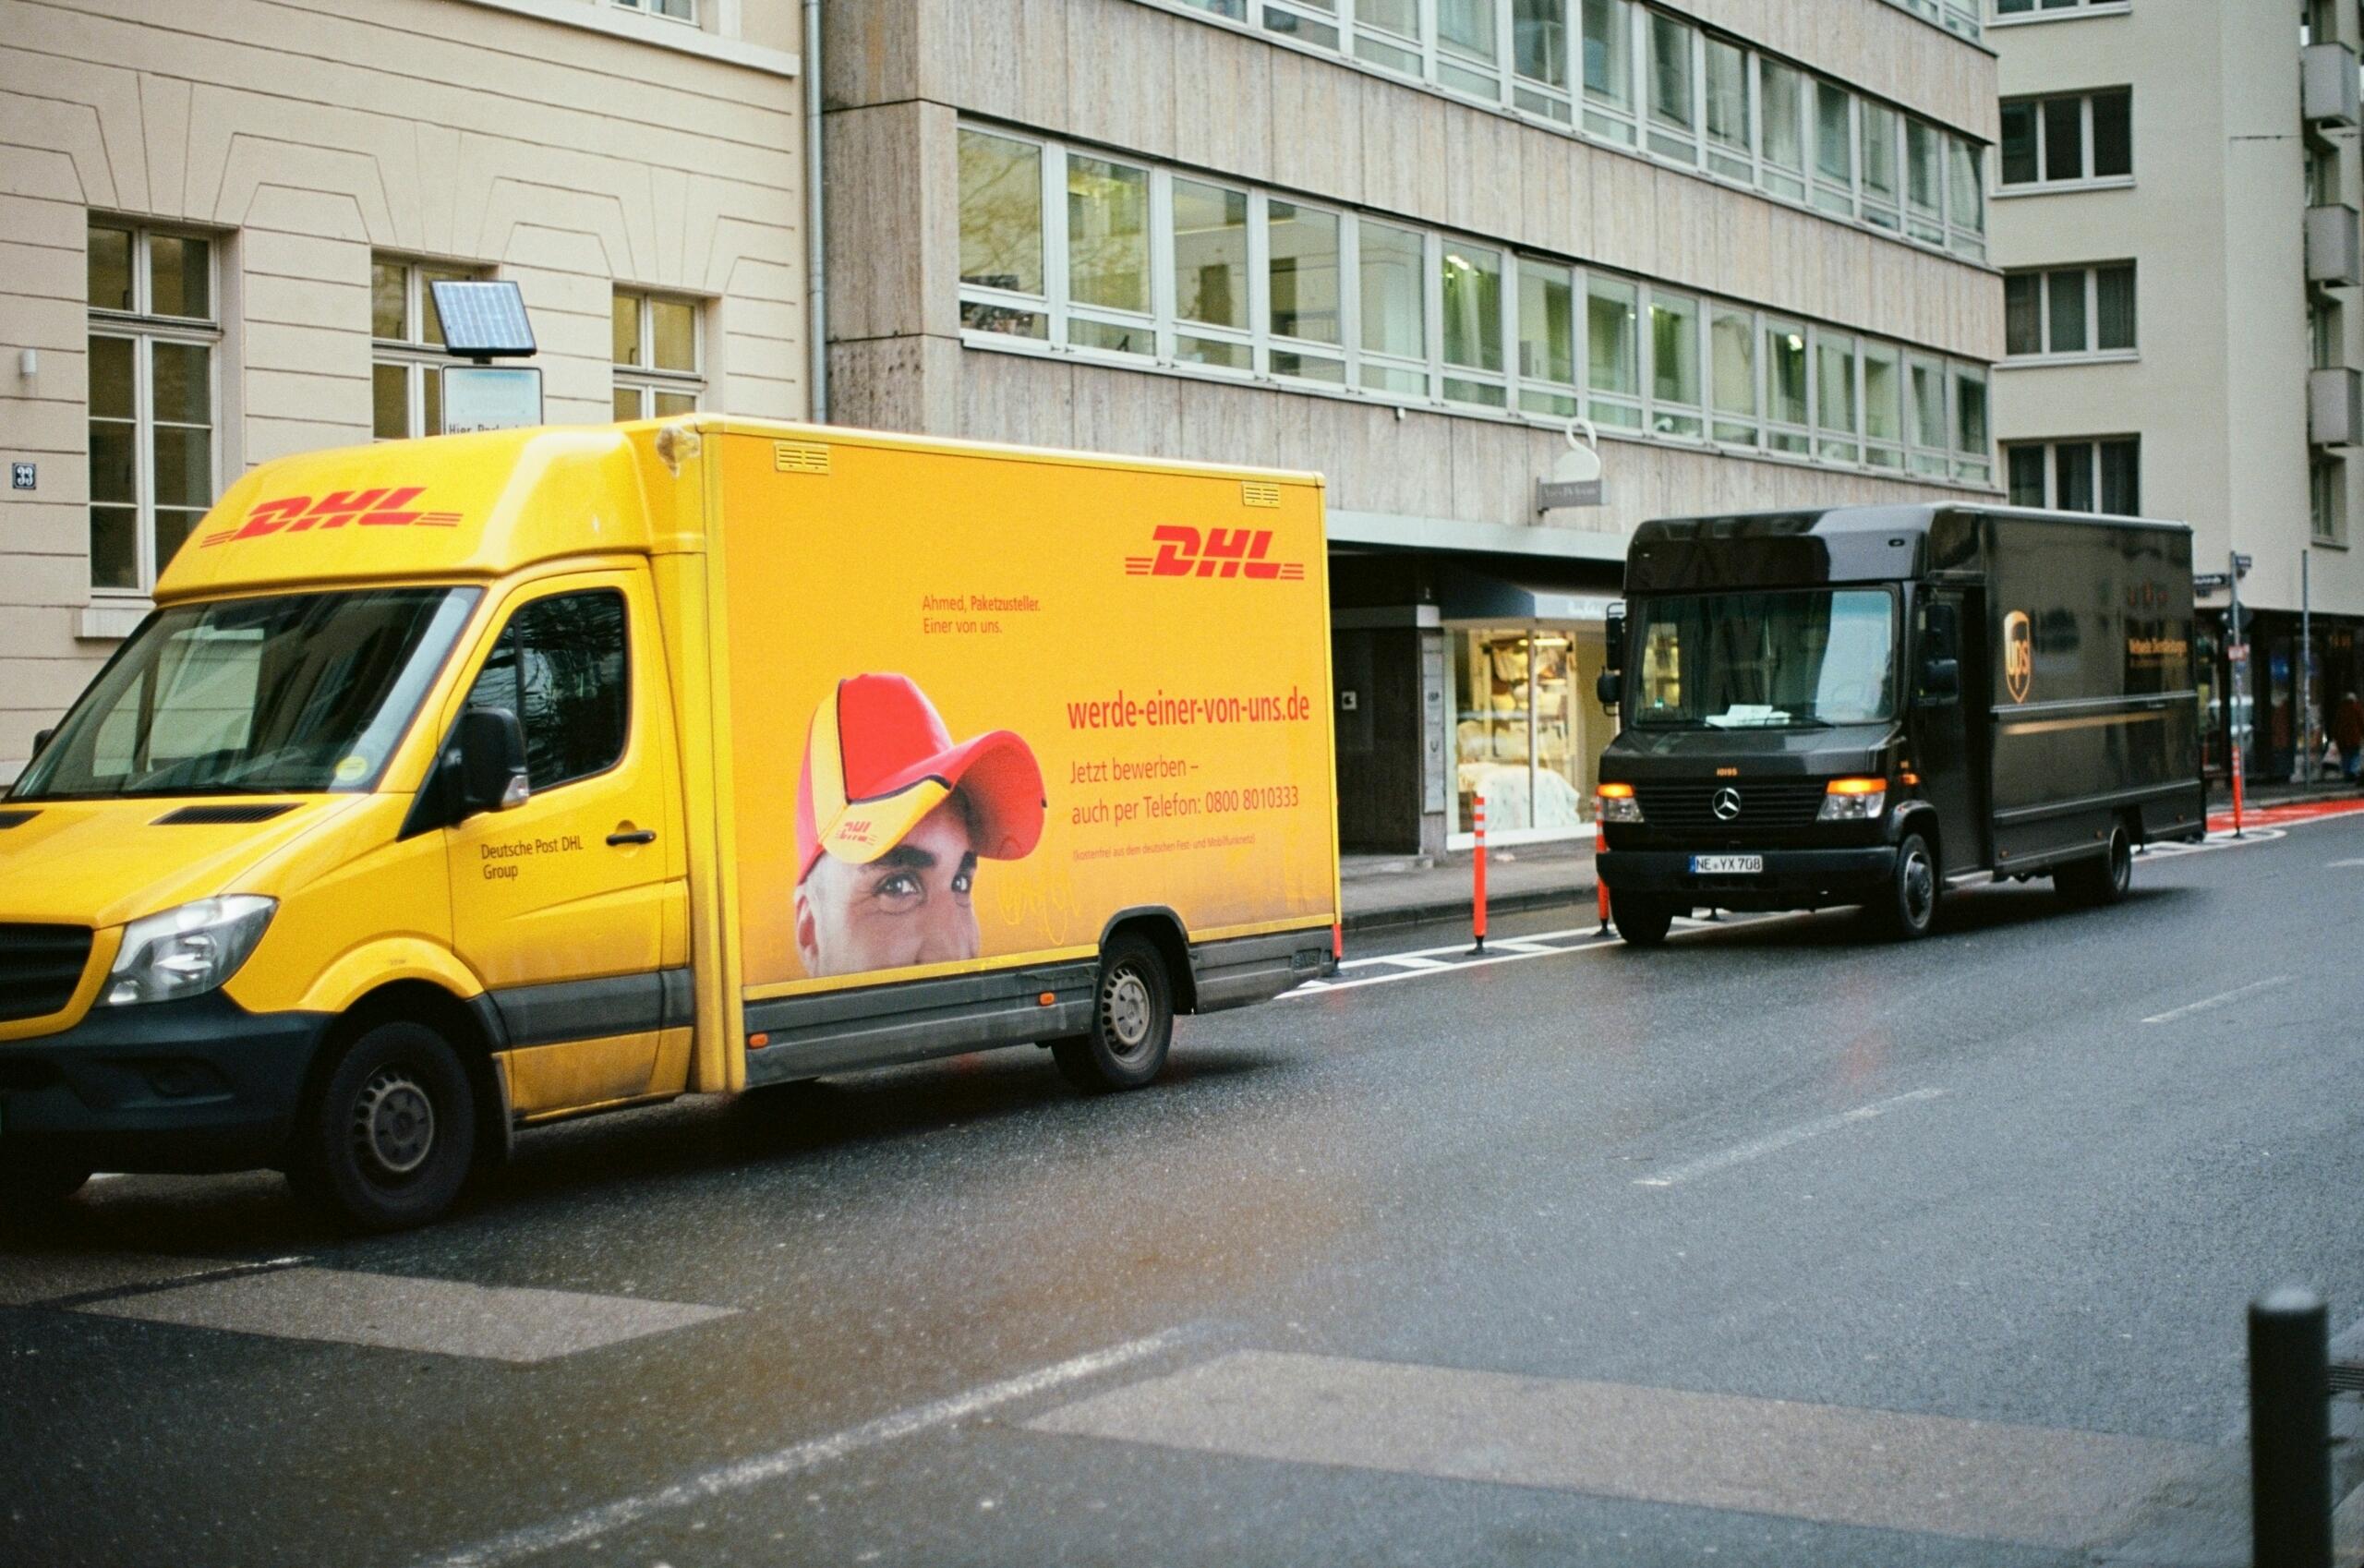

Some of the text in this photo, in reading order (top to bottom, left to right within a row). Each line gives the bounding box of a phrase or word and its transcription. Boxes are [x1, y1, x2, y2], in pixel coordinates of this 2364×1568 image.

[17, 466, 33, 486] 33
[229, 487, 428, 542] DHL
[1152, 525, 1282, 580] DHL
[923, 595, 1041, 613] Ahmed, Paketzusteller.
[923, 617, 1003, 633] Einer von uns.
[2004, 638, 2030, 689] ups
[1067, 685, 1310, 730] werde-einer-von-uns.de
[1070, 760, 1108, 784] Jetzt
[1112, 754, 1187, 781] bewerben
[1072, 785, 1298, 826] auch per Telefon: 0800 8010333
[481, 835, 584, 860] Deutsche Post DHL
[483, 864, 518, 882] Group
[1696, 857, 1761, 870] NE YX 708
